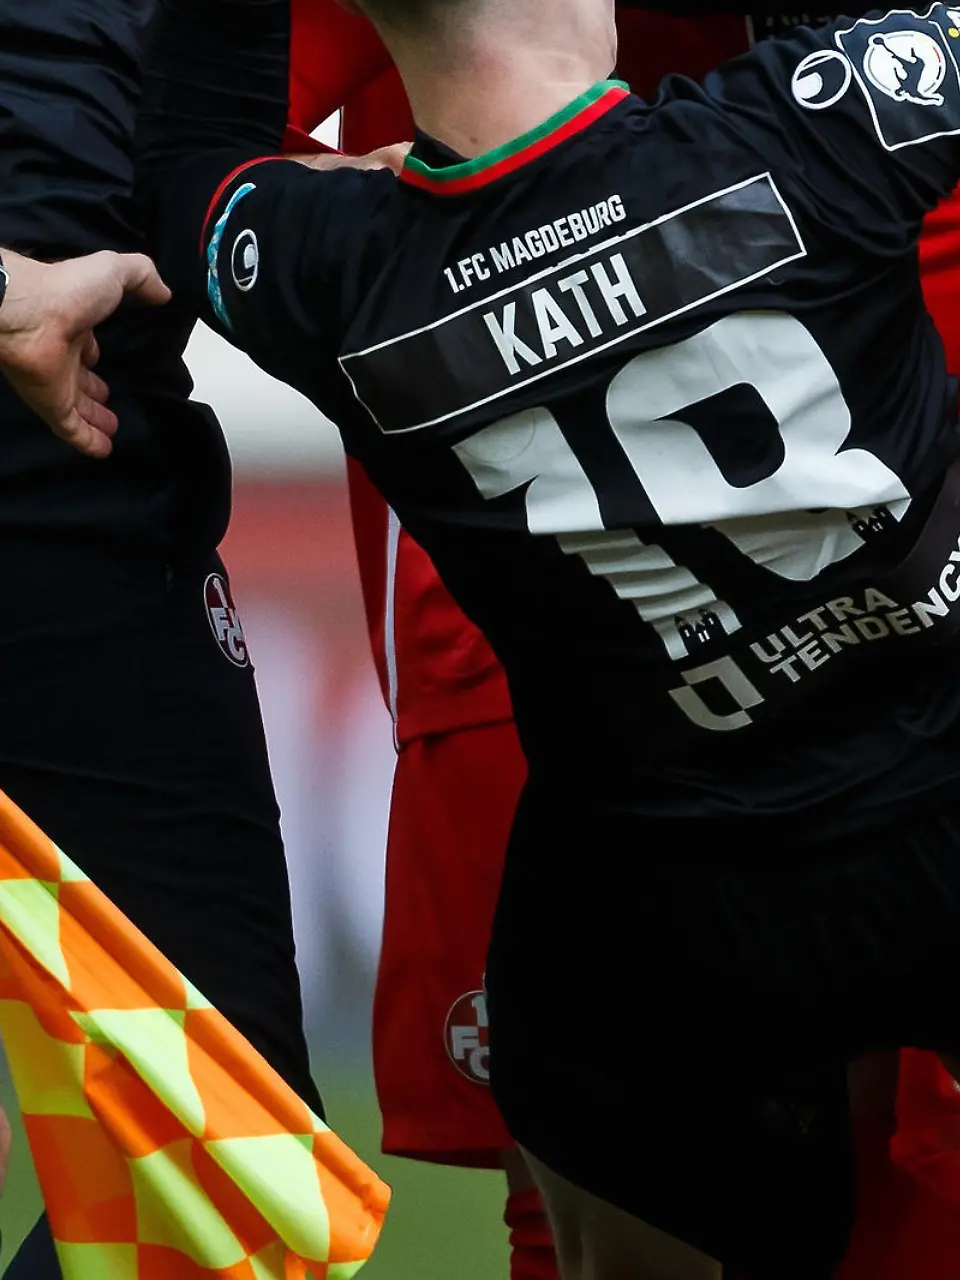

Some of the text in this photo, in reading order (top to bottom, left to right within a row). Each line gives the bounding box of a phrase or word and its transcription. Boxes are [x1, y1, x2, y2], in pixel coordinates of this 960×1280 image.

[444, 194, 627, 294] 1.FC MAGDEBURG
[483, 253, 648, 376] KATH
[452, 310, 912, 661] 18
[750, 587, 899, 663] ULTRA
